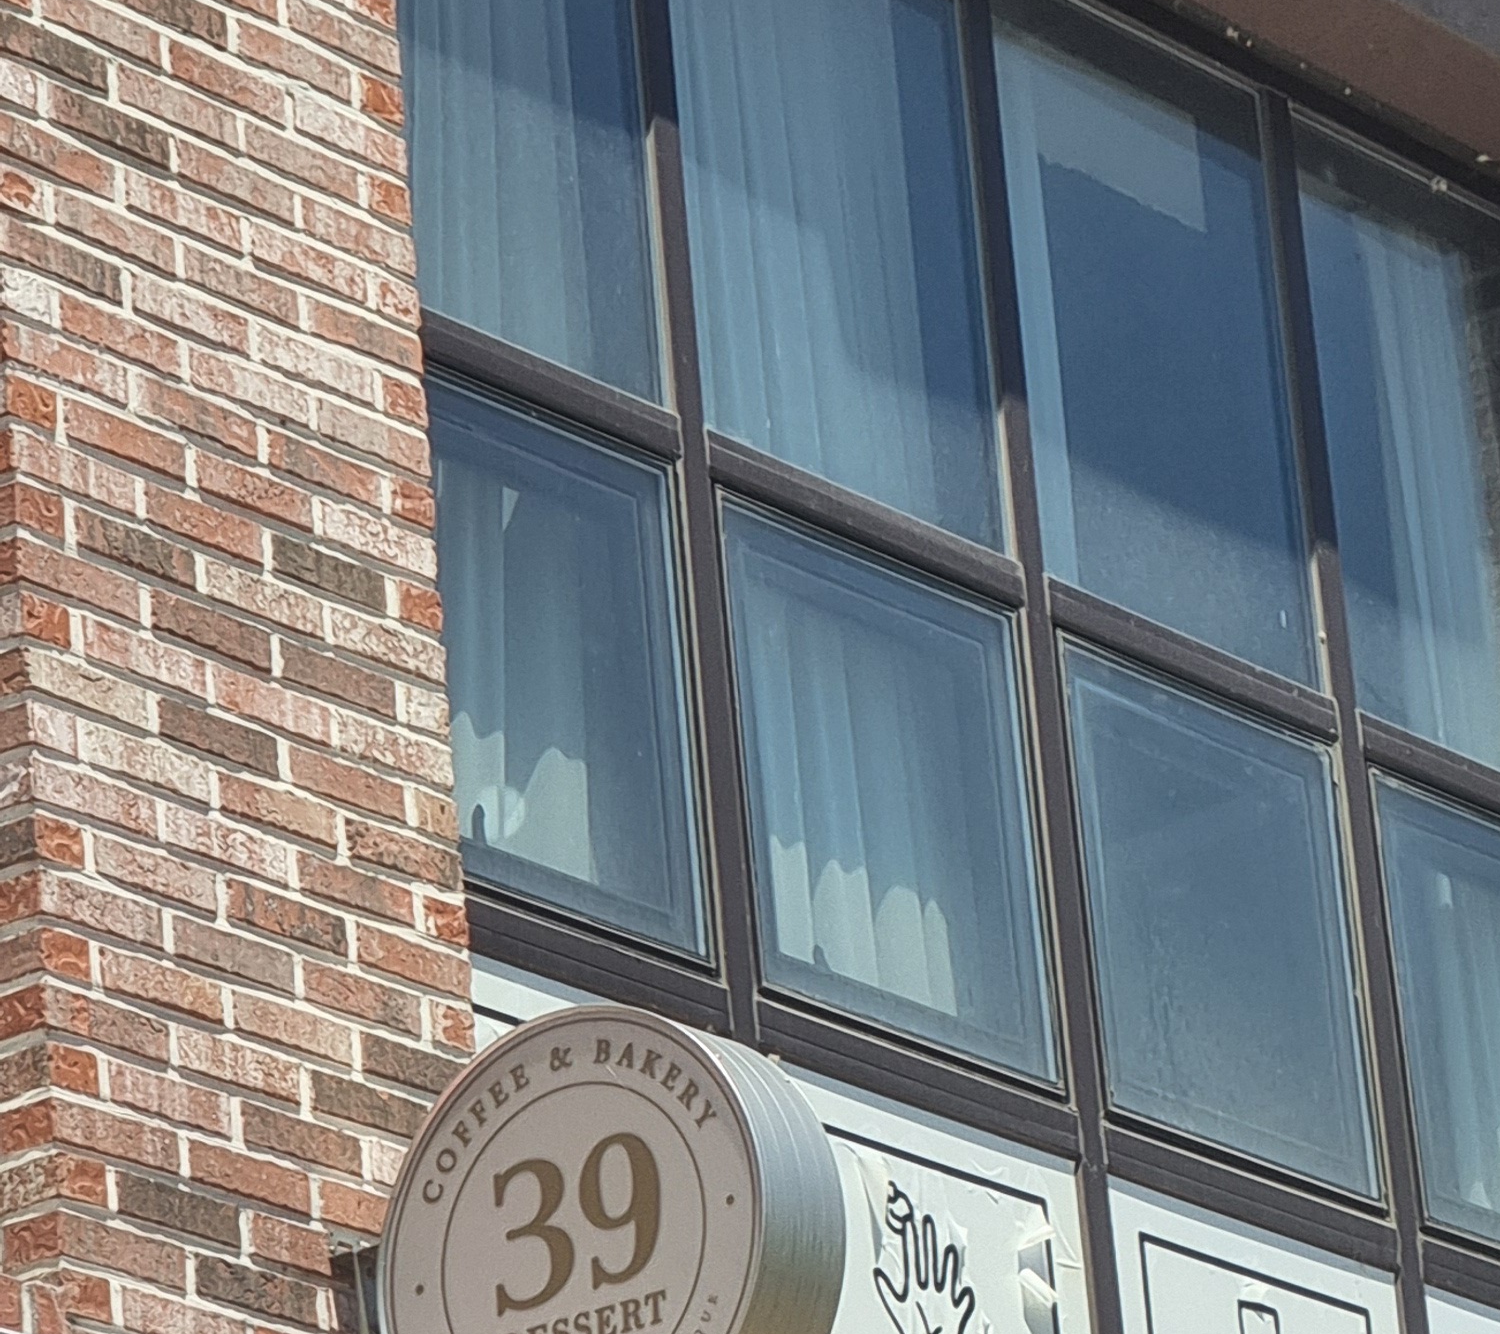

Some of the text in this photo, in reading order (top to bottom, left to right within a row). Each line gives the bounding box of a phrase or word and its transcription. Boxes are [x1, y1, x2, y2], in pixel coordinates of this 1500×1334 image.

[422, 1038, 717, 1205] COFFEE & BAKERY
[492, 1132, 661, 1318] 39
